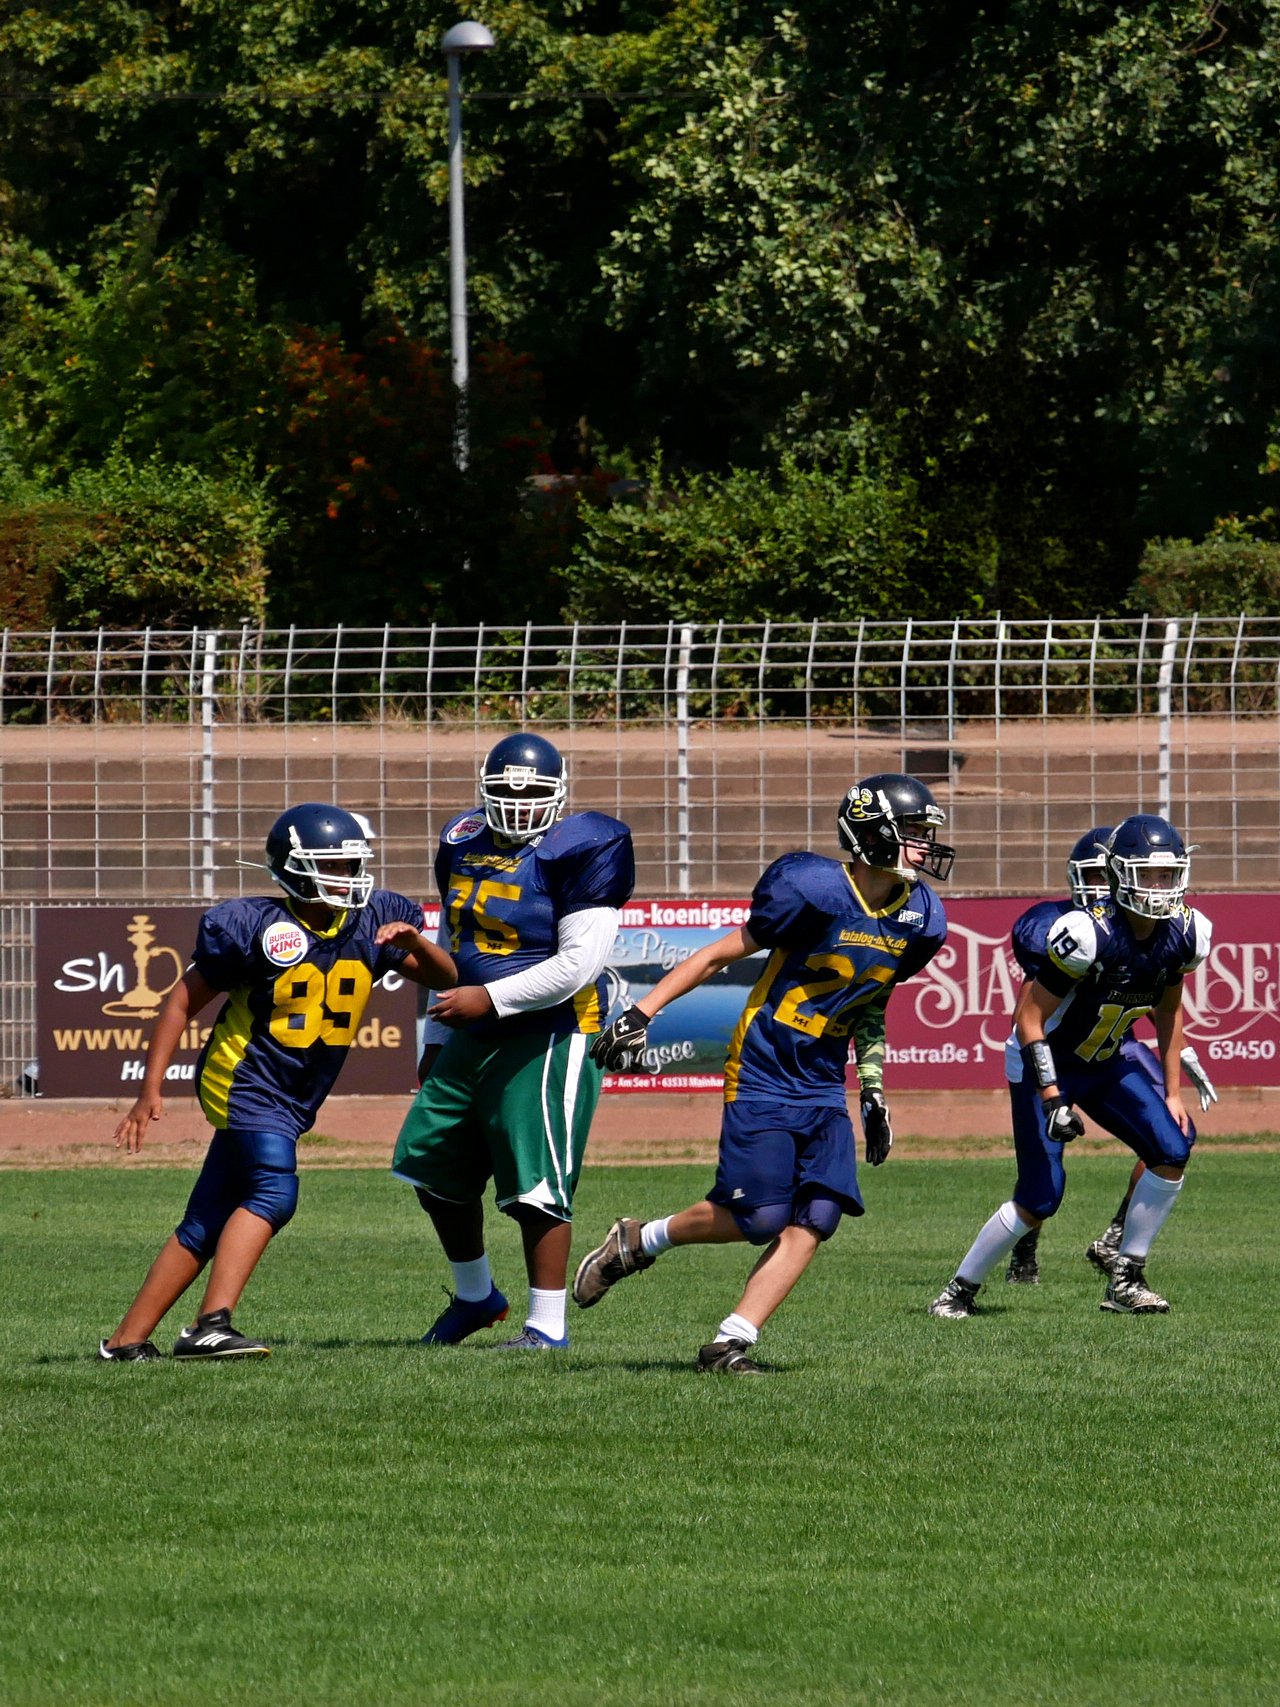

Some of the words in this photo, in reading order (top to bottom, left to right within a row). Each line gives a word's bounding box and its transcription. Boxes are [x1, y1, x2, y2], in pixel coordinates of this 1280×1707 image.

[448, 872, 523, 957] 75
[268, 931, 301, 945] BURGER
[268, 938, 303, 956] KING
[1051, 926, 1079, 961] 19
[268, 959, 373, 1049] 89
[972, 1043, 985, 1062] 1
[1207, 1041, 1276, 1061] 63450
